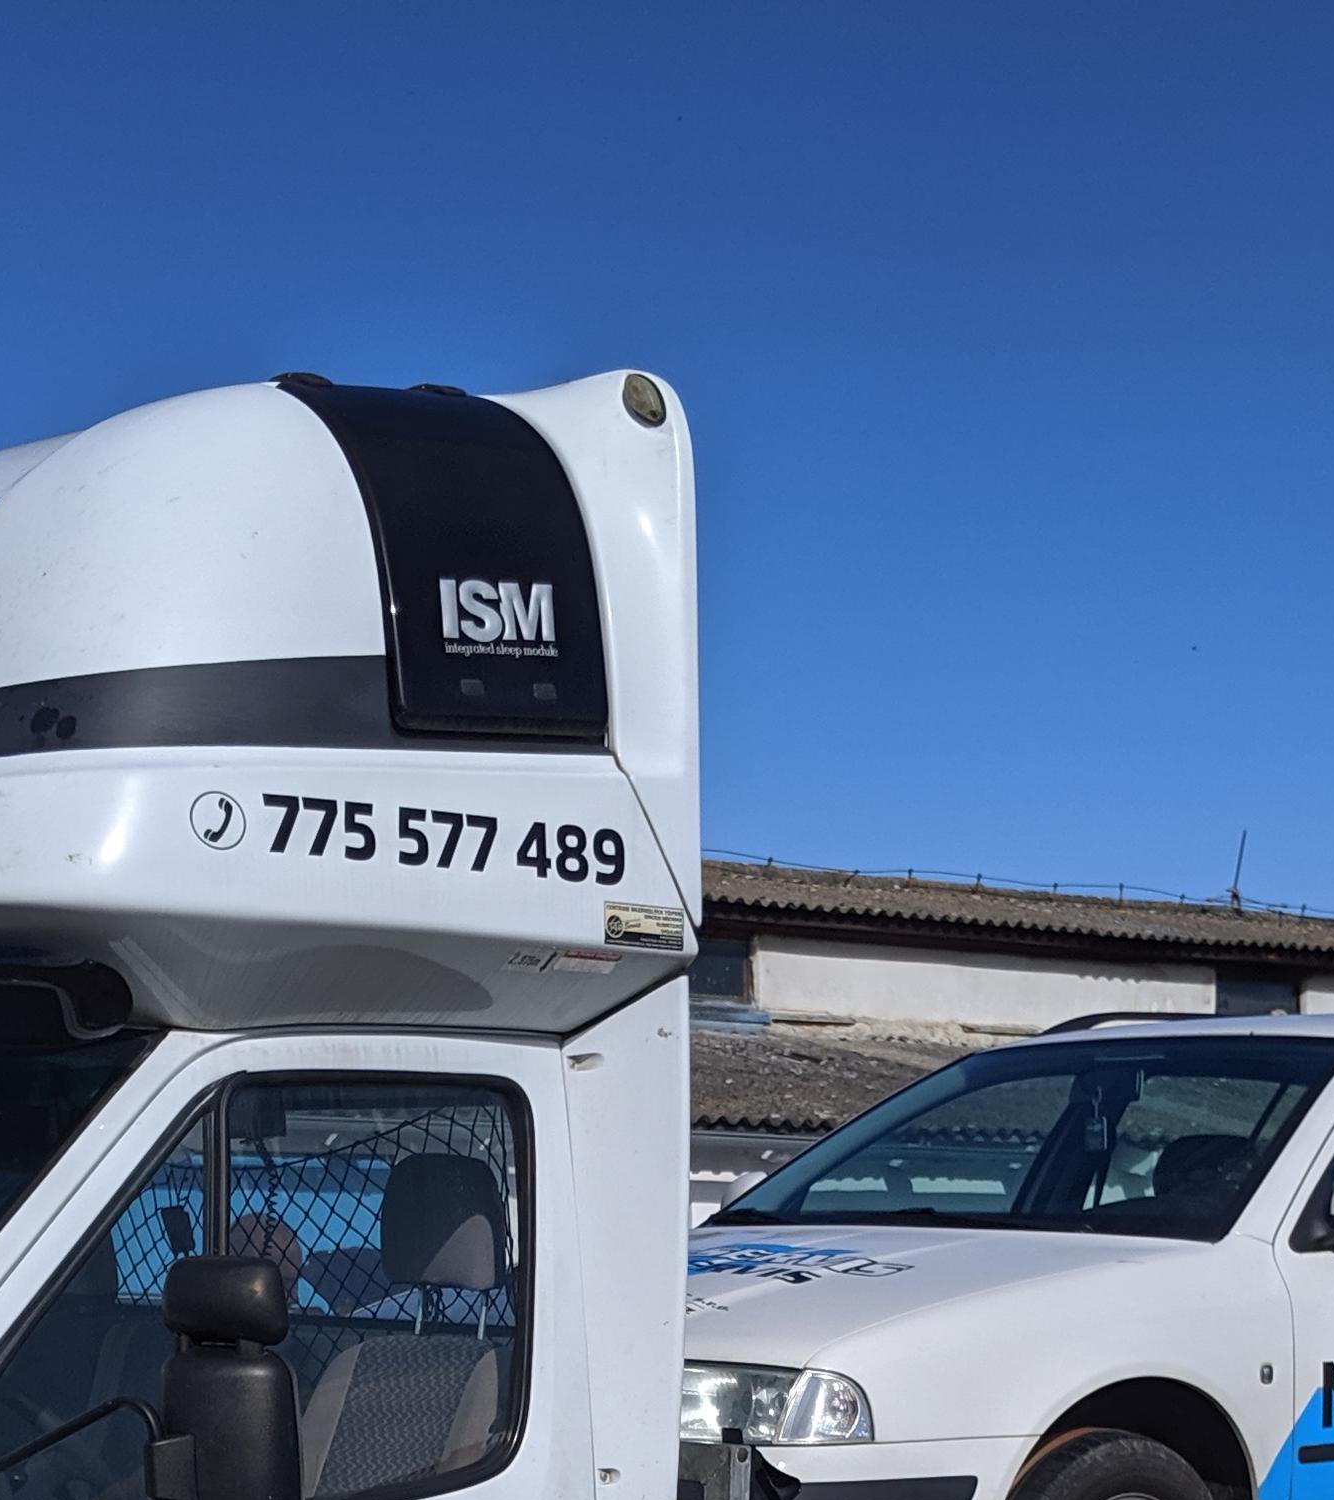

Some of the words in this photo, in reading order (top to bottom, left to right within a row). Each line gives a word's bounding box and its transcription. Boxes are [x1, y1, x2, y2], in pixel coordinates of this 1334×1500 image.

[439, 578, 555, 642] ISM
[444, 642, 495, 656] integrated
[496, 643, 522, 658] sleep
[523, 644, 558, 657] module
[262, 793, 376, 861] 775
[398, 807, 498, 873] 577
[516, 822, 626, 887] 489
